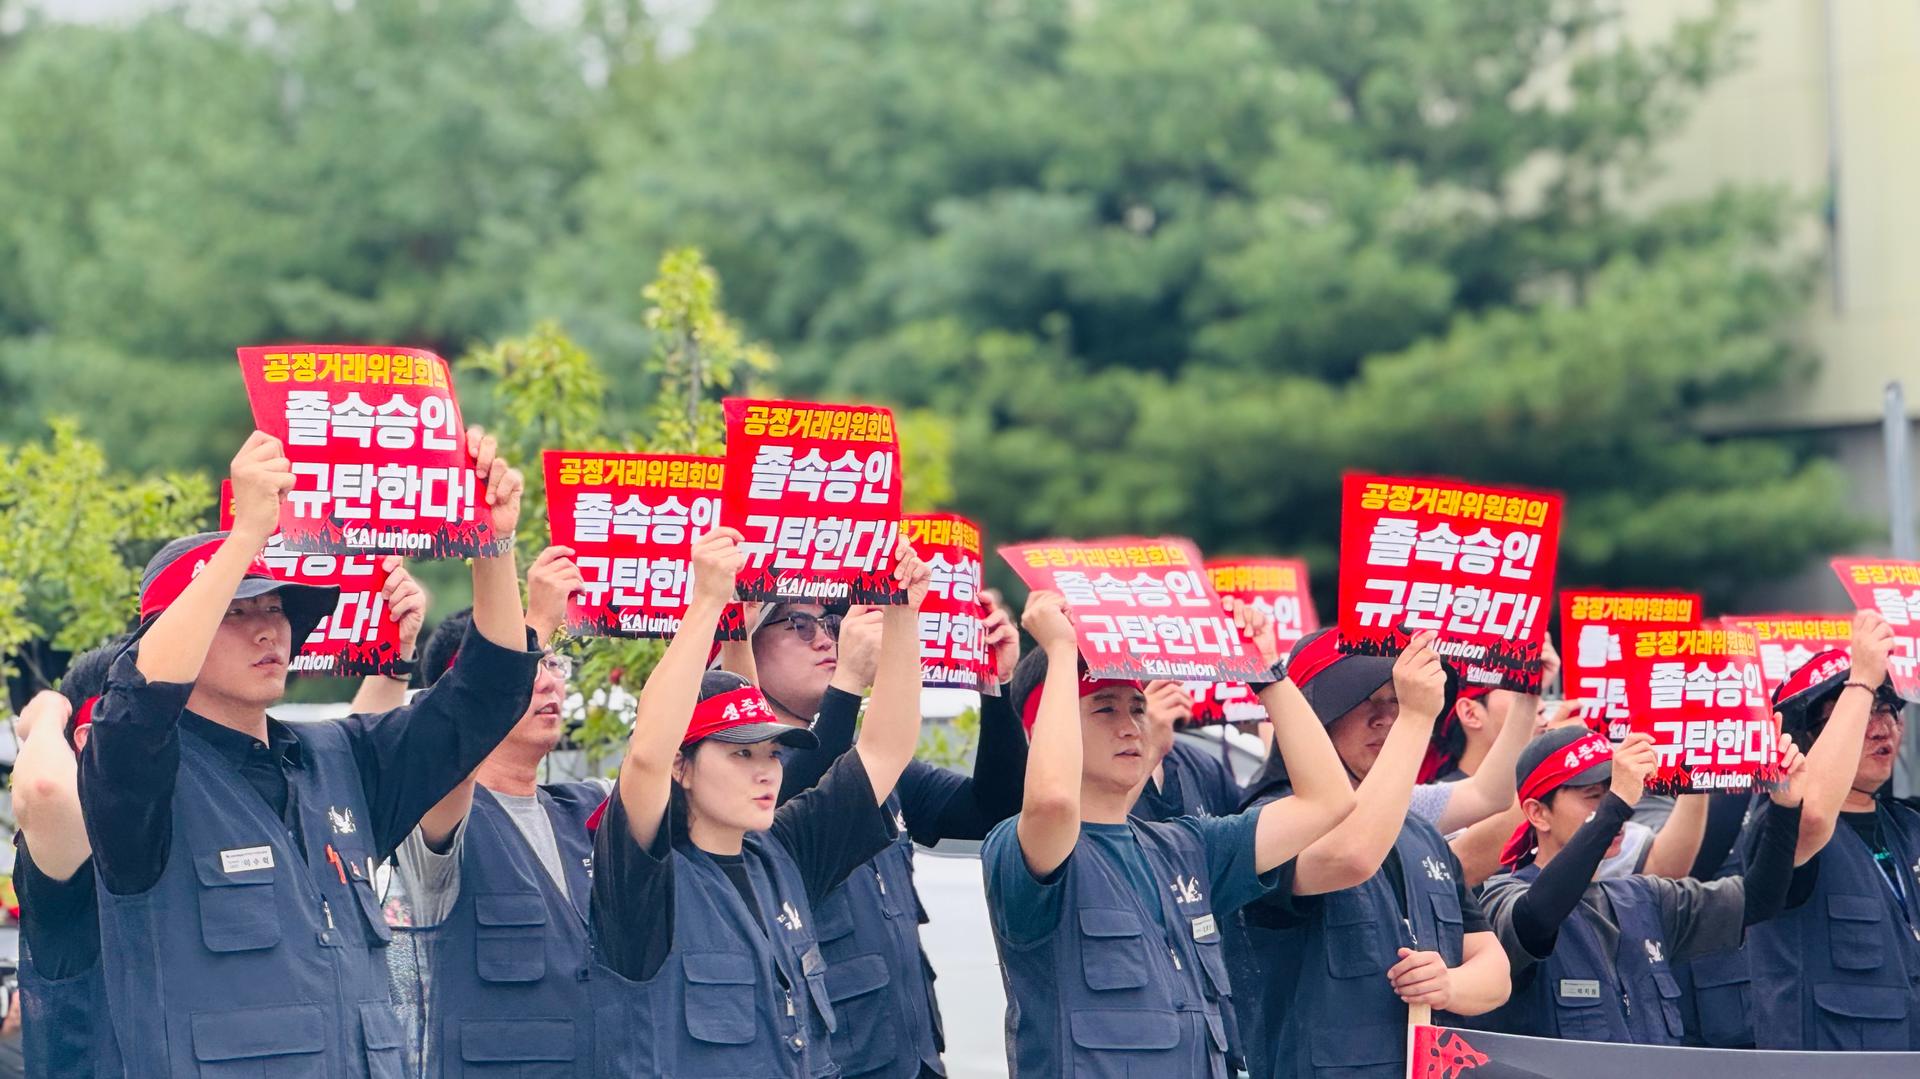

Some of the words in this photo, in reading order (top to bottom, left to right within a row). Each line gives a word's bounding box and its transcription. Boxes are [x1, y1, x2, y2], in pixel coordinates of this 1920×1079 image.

[262, 352, 449, 388] 공정거래위원회의
[285, 390, 457, 451] 졸속승인
[744, 406, 893, 443] 공정거래위원회의
[287, 462, 476, 522] 규탄한다!
[559, 458, 725, 490] 공정거래위원회의
[748, 445, 893, 504] 졸속승인
[573, 493, 722, 545] 졸속승인
[1361, 483, 1548, 528] 공정거래위원회의
[377, 528, 431, 550] union
[737, 515, 898, 571] 규탄한다!
[1023, 546, 1191, 568] 공정거래위원회의
[1366, 517, 1541, 580] 졸속승인
[803, 577, 848, 598] union
[1053, 571, 1211, 607] 졸속승인
[1355, 579, 1541, 640] 규탄한다!
[1571, 596, 1692, 622] 공정거래위원회의
[1079, 615, 1244, 657] 규탄한다!
[1635, 630, 1757, 658] 공정거래위원회의
[1172, 660, 1216, 677] union
[1649, 662, 1765, 709] 졸속승인
[1651, 719, 1777, 768] 규탄한다!
[1715, 771, 1751, 789] union
